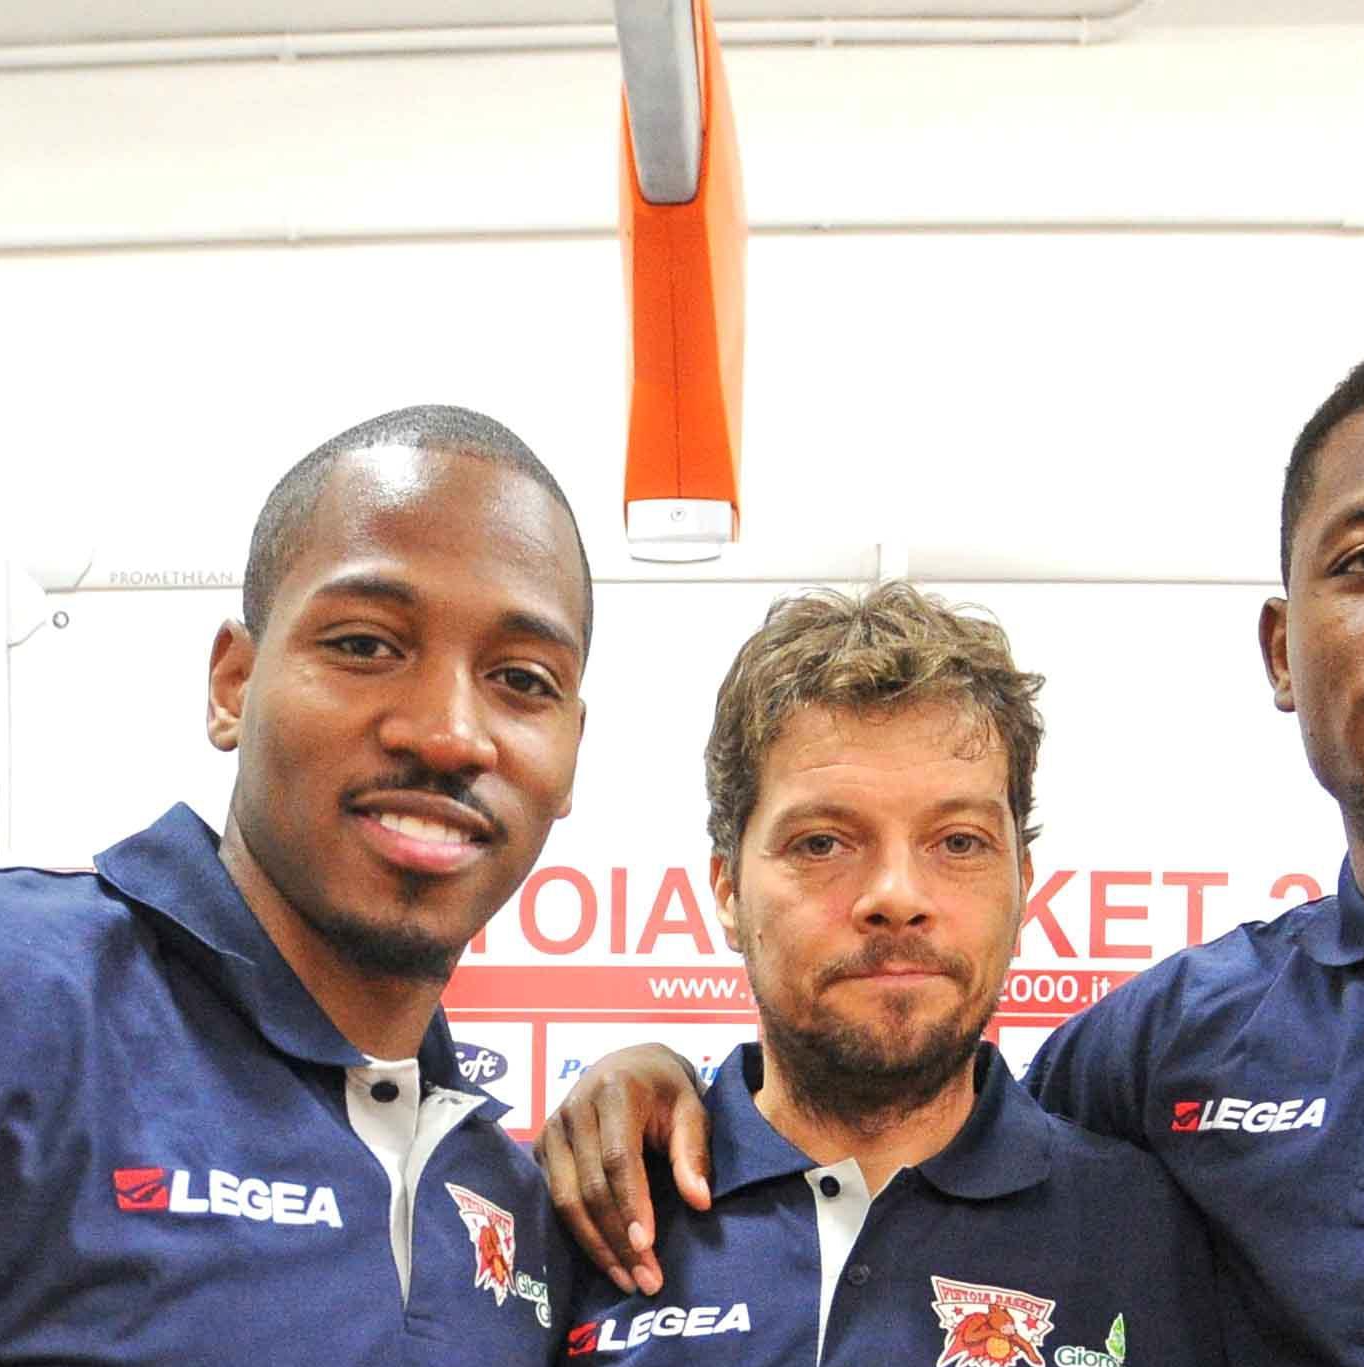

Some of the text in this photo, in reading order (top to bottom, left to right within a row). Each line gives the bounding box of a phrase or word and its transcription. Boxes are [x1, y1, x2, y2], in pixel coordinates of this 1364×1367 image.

[470, 866, 715, 955] OIA
[456, 1050, 500, 1081] oft
[1198, 1097, 1327, 1133] LEGEA
[169, 1169, 343, 1228] LEGEA
[596, 1303, 752, 1351] LEGEA
